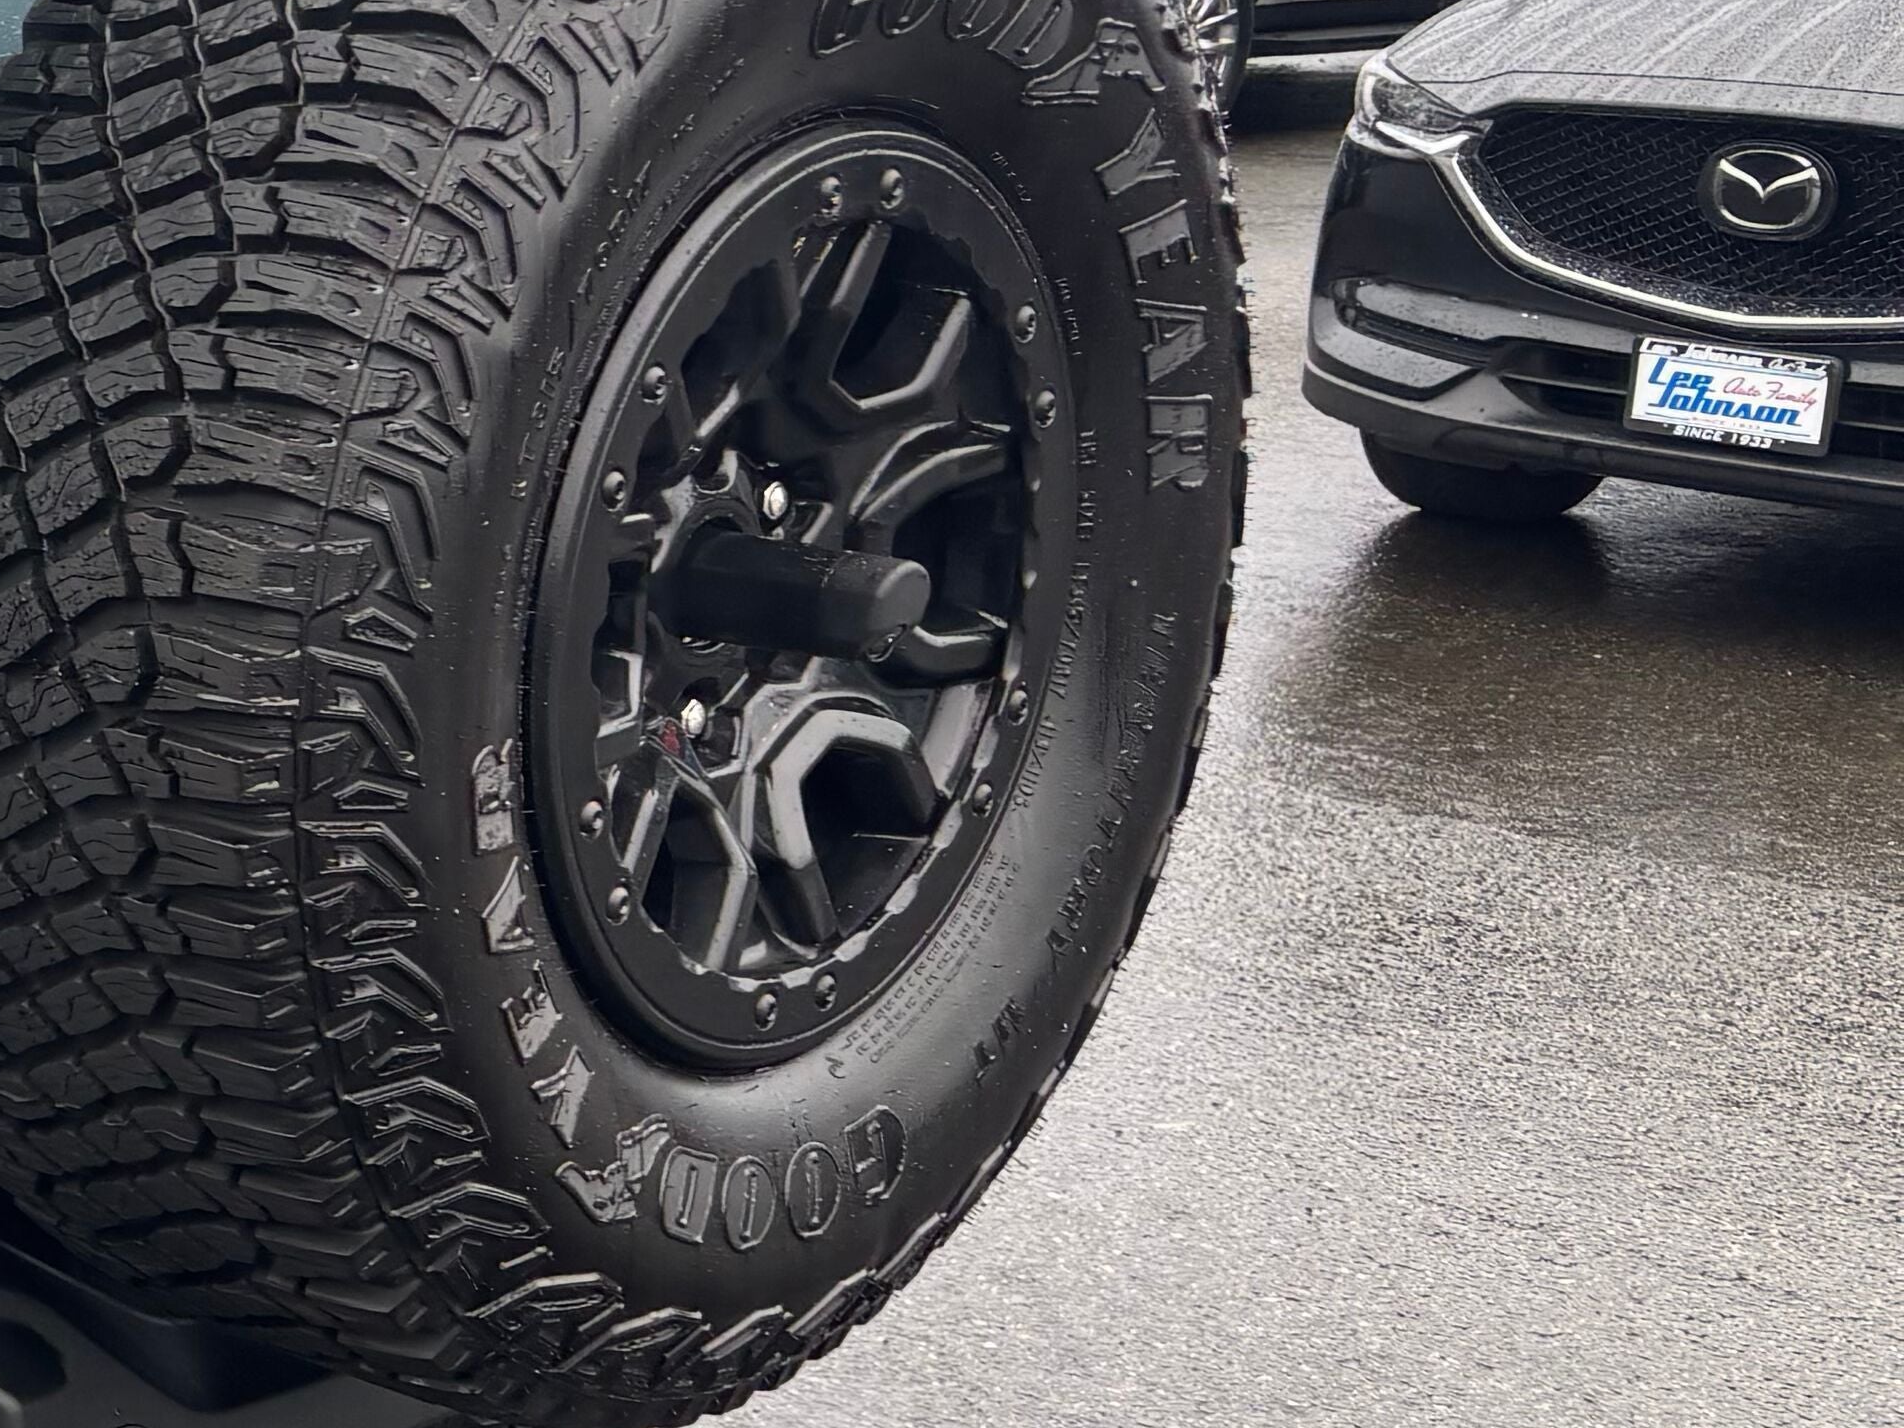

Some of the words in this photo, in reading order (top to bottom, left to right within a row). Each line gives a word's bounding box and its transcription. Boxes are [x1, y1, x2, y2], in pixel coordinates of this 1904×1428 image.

[1648, 357, 1714, 390] Lee
[1648, 381, 1803, 427] Johnson
[1723, 377, 1761, 398] Auto
[1766, 381, 1818, 412] Family
[1673, 424, 1725, 443] SINCE
[1730, 433, 1774, 450] 1933
[471, 737, 909, 1252] GOODYEAR
